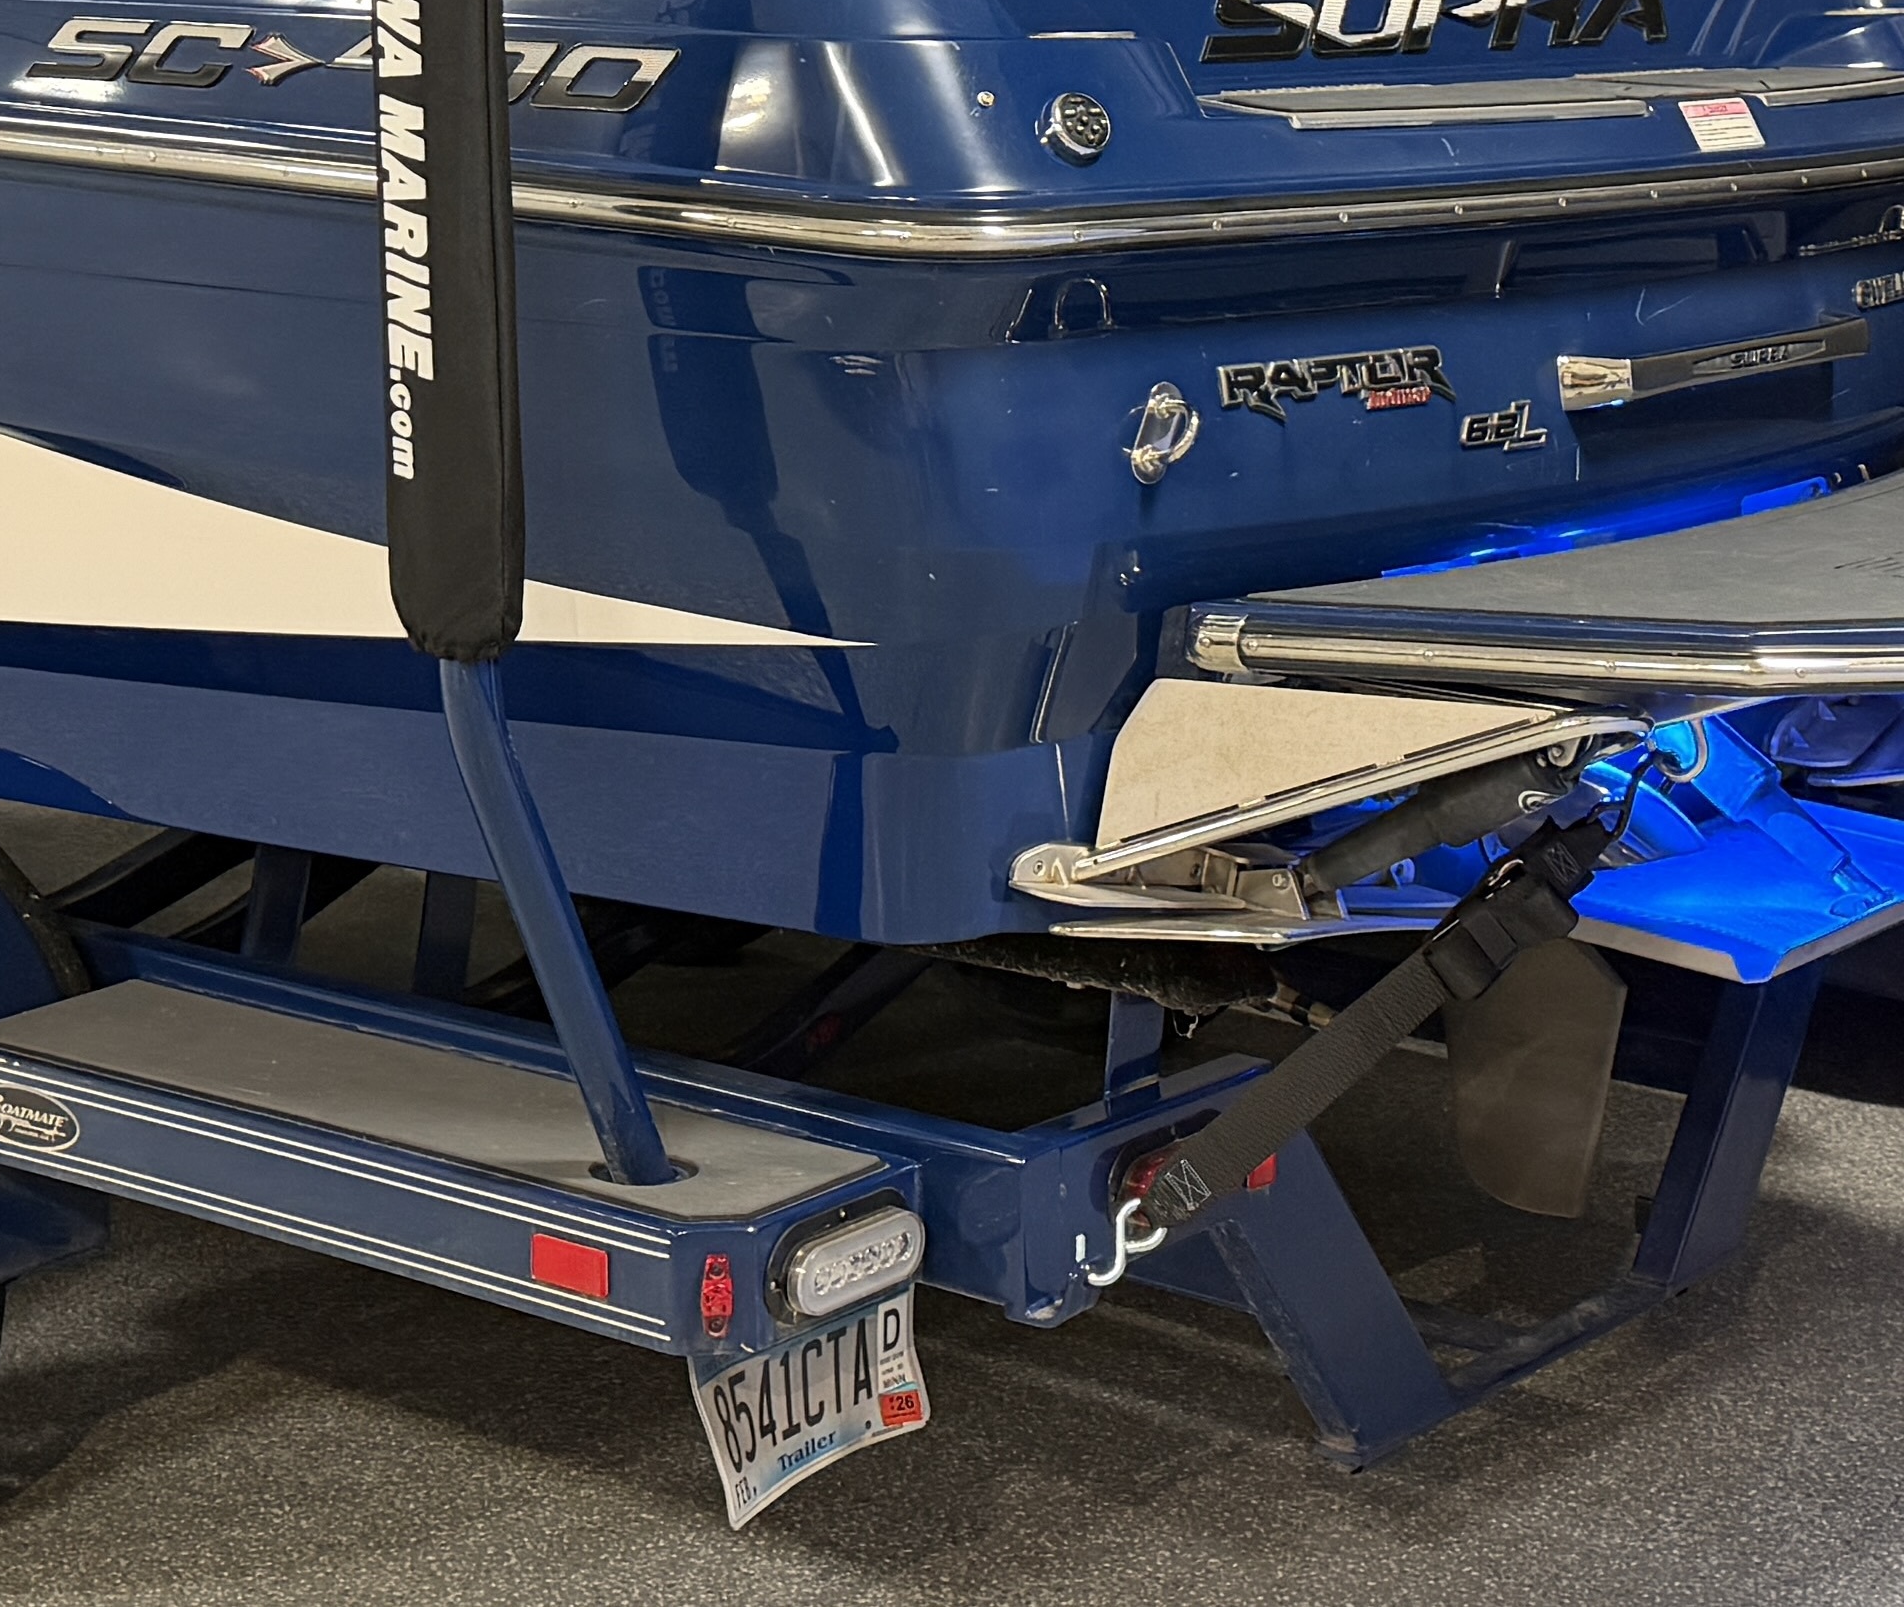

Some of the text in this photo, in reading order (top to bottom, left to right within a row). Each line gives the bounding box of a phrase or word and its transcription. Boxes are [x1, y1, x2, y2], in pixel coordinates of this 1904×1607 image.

[1217, 345, 1457, 422] RAPTOR
[713, 1318, 873, 1473] 8541CTA
[778, 1430, 837, 1472] Trailer
